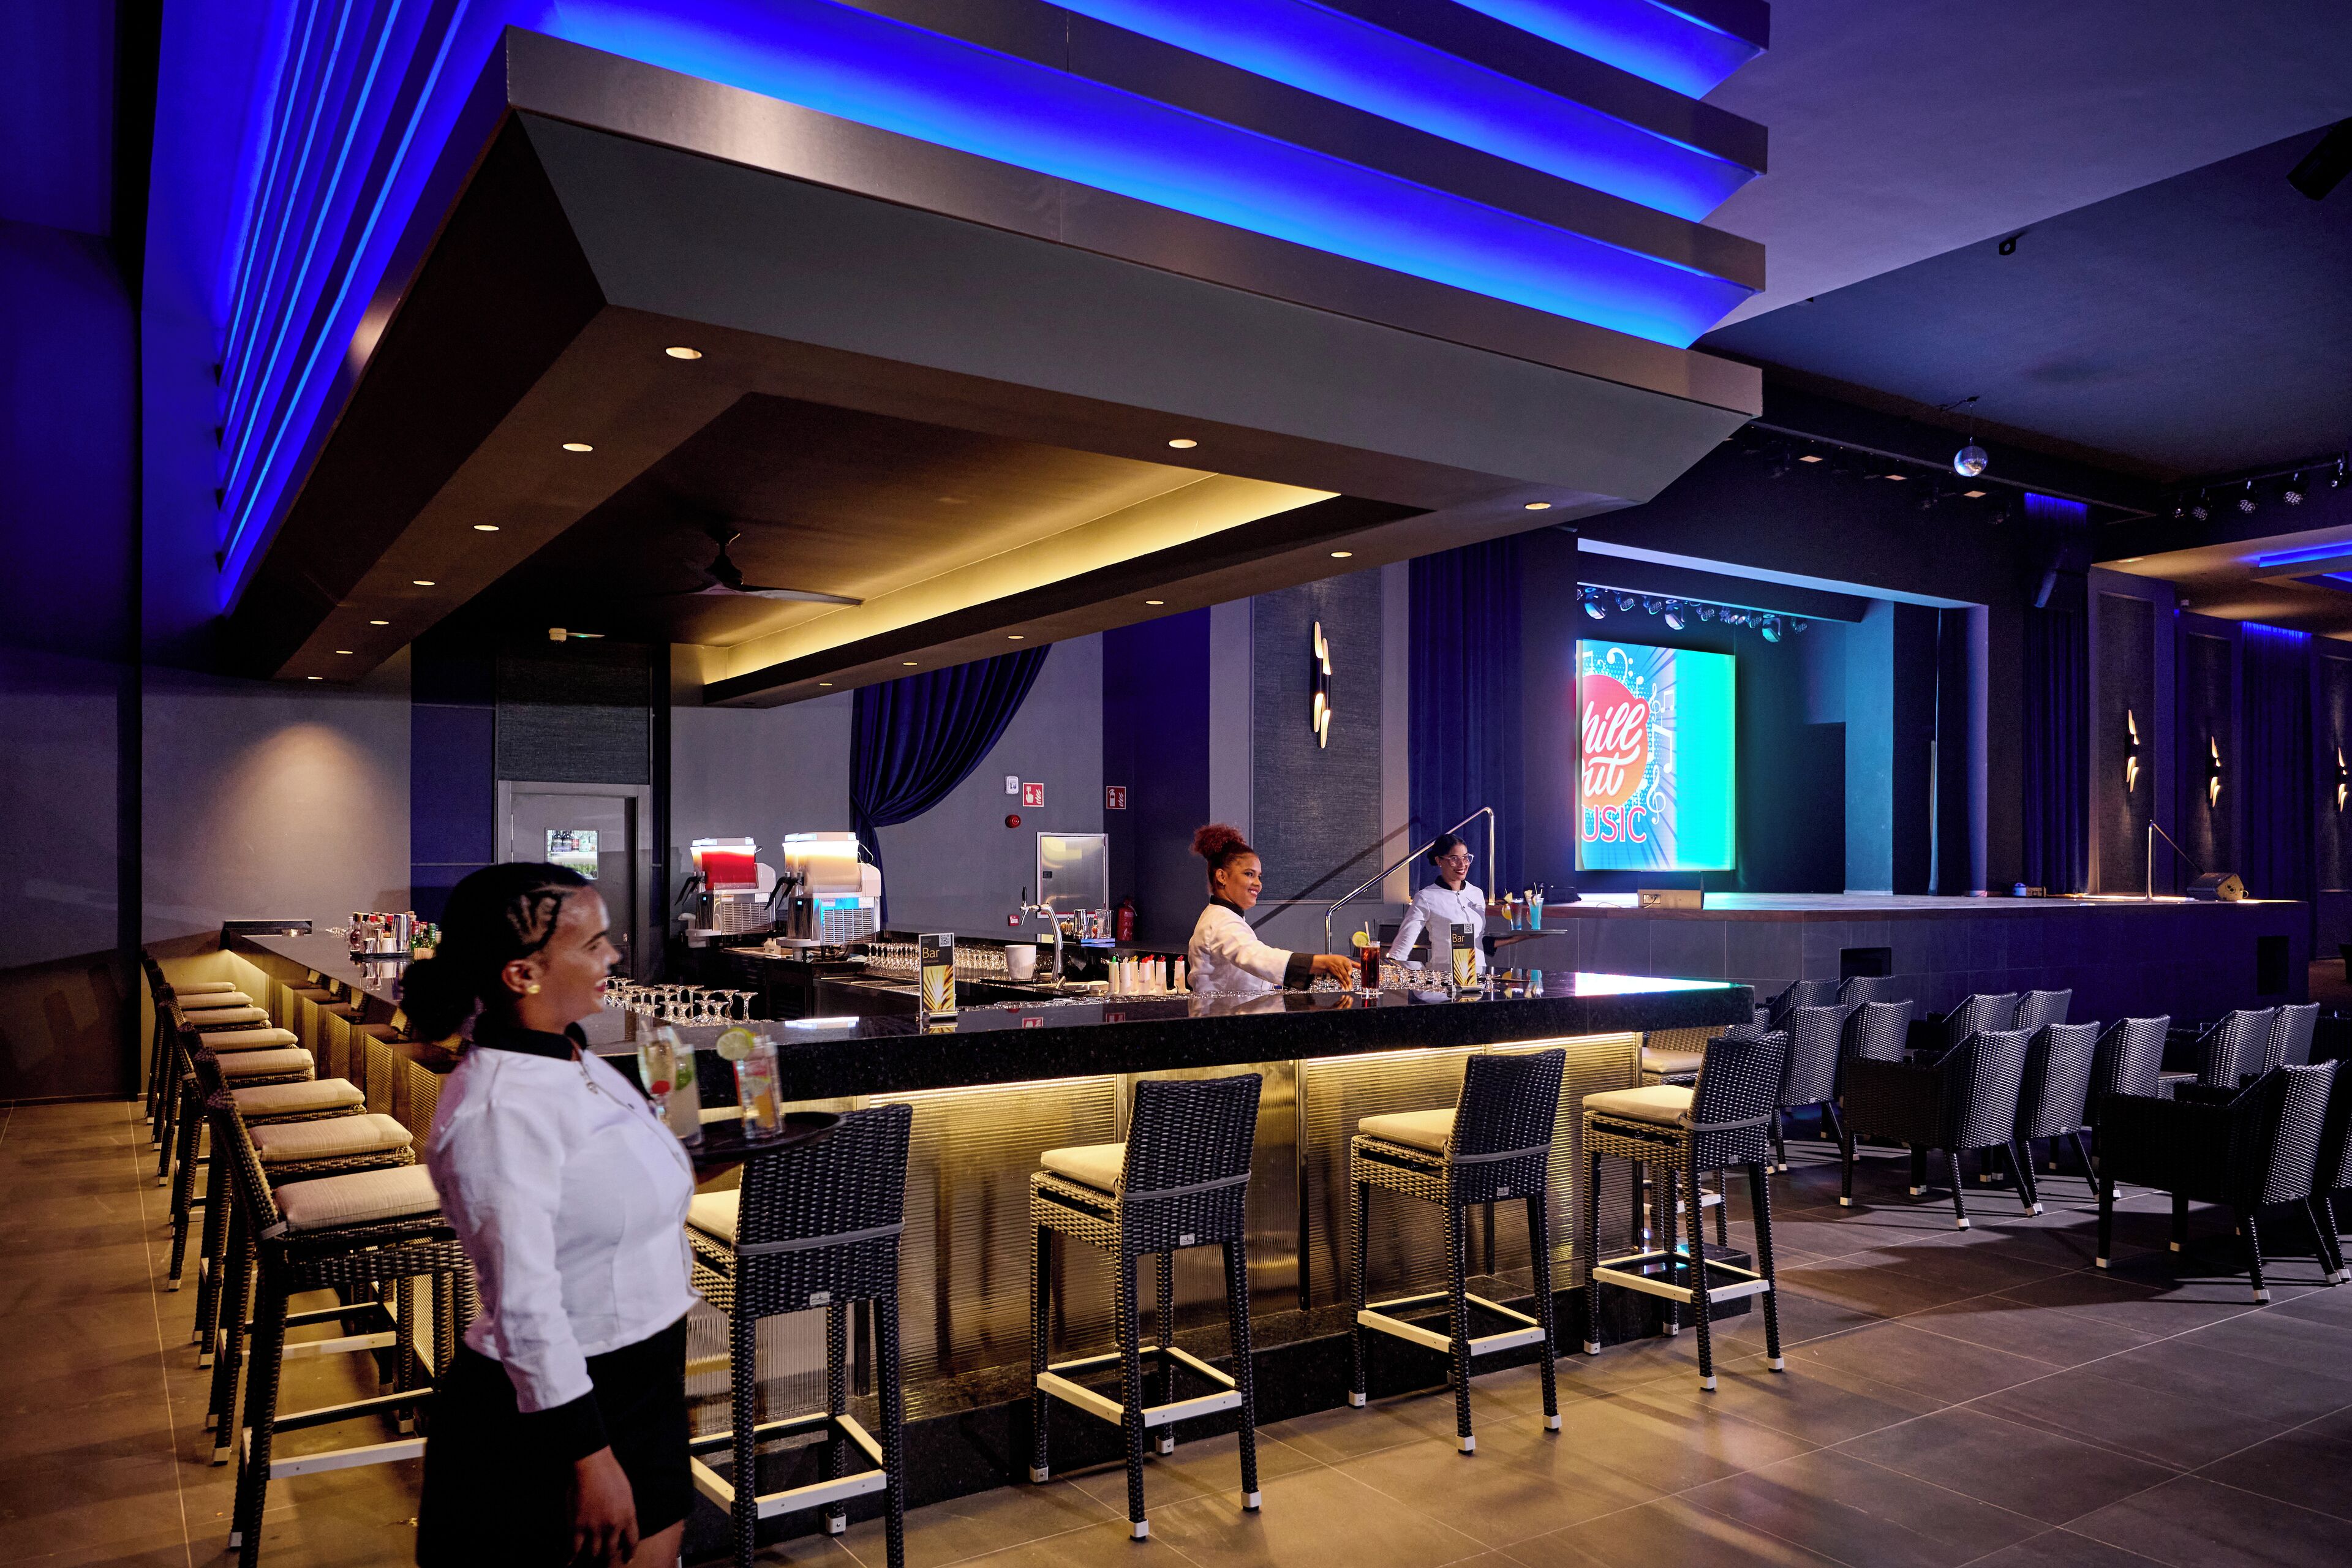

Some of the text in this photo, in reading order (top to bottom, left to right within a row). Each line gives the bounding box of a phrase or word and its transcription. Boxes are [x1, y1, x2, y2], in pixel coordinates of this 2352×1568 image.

[1582, 700, 1646, 753] hill
[1582, 744, 1641, 797] ut
[1581, 804, 1647, 843] USIC
[922, 947, 940, 959] Bar
[1452, 933, 1464, 943] Bar
